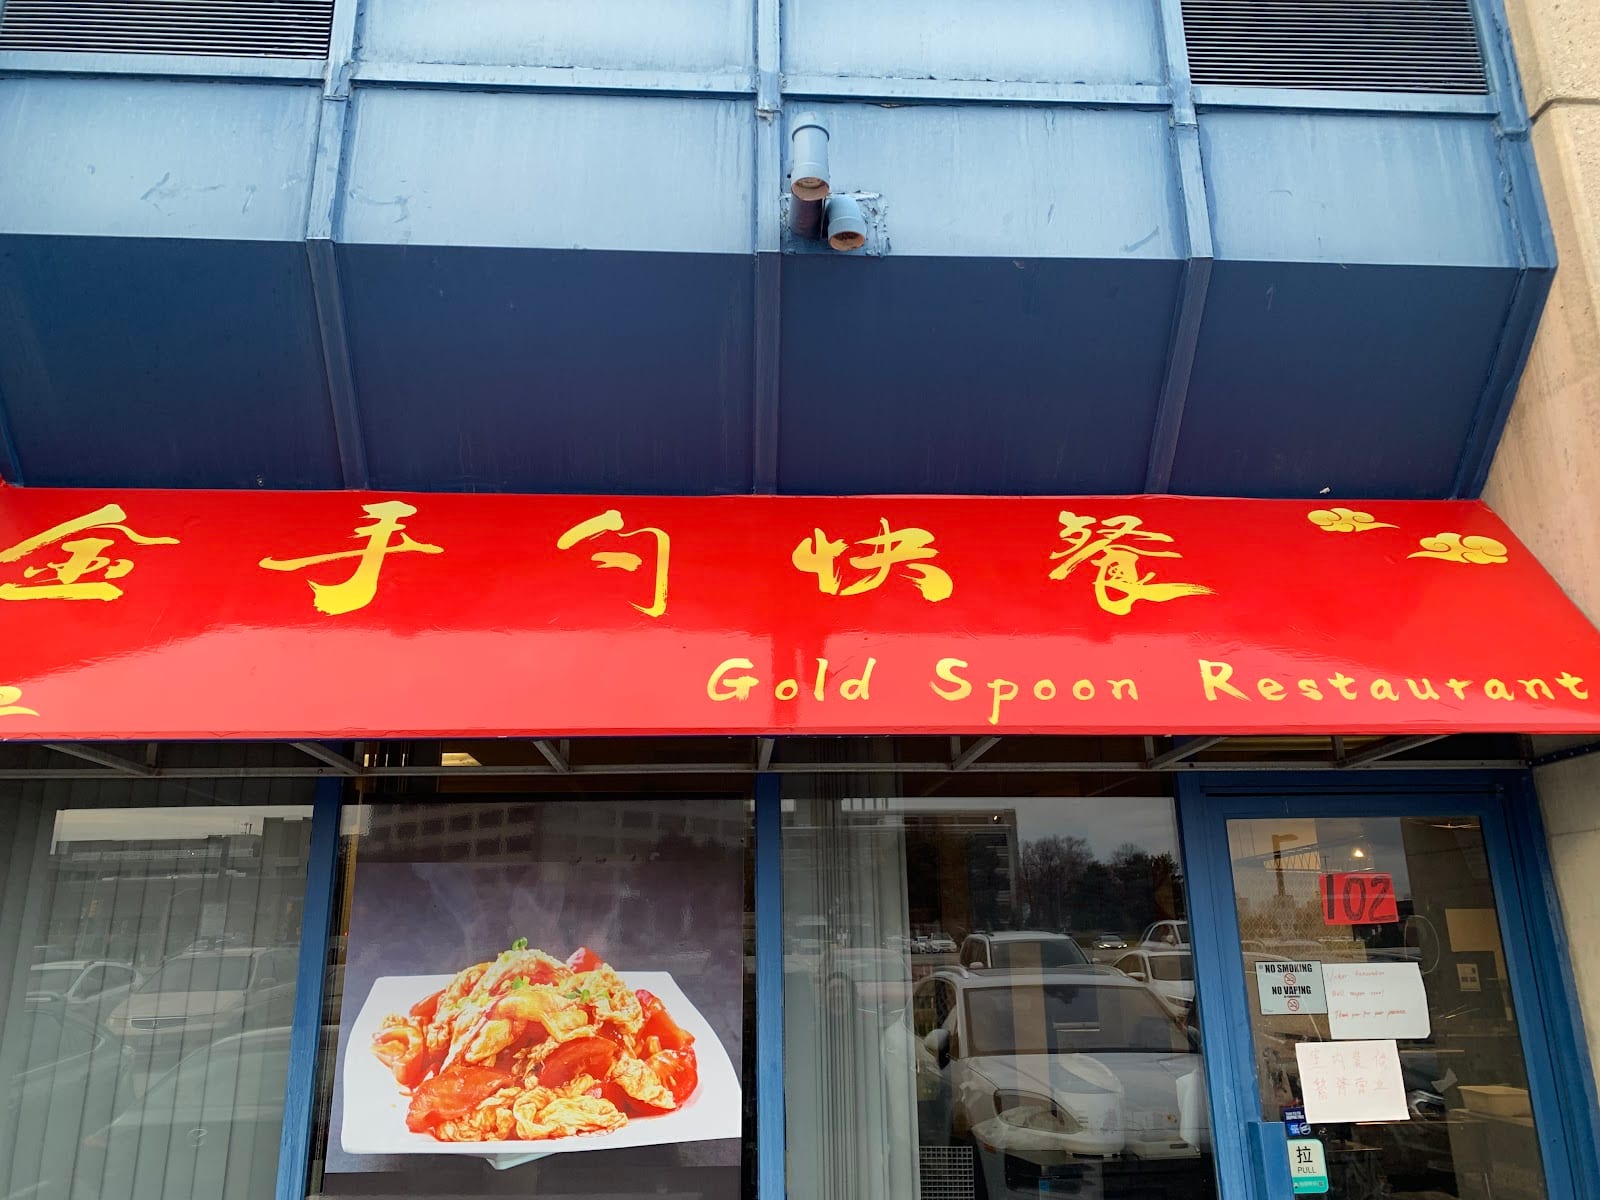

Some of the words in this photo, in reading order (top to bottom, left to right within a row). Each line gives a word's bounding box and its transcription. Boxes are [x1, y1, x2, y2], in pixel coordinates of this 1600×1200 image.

[0, 501, 1212, 618] 金手勺快餐
[707, 656, 877, 704] Gold
[931, 656, 1139, 725] Spoon
[1199, 658, 1589, 704] Restaurant
[1326, 874, 1397, 921] 102
[1264, 964, 1276, 973] NO
[1277, 963, 1313, 973] SMOKING
[1271, 985, 1283, 995] NO
[1283, 985, 1312, 995] VAPING
[1295, 1145, 1313, 1164] 拉
[1297, 1166, 1317, 1174] PULL
